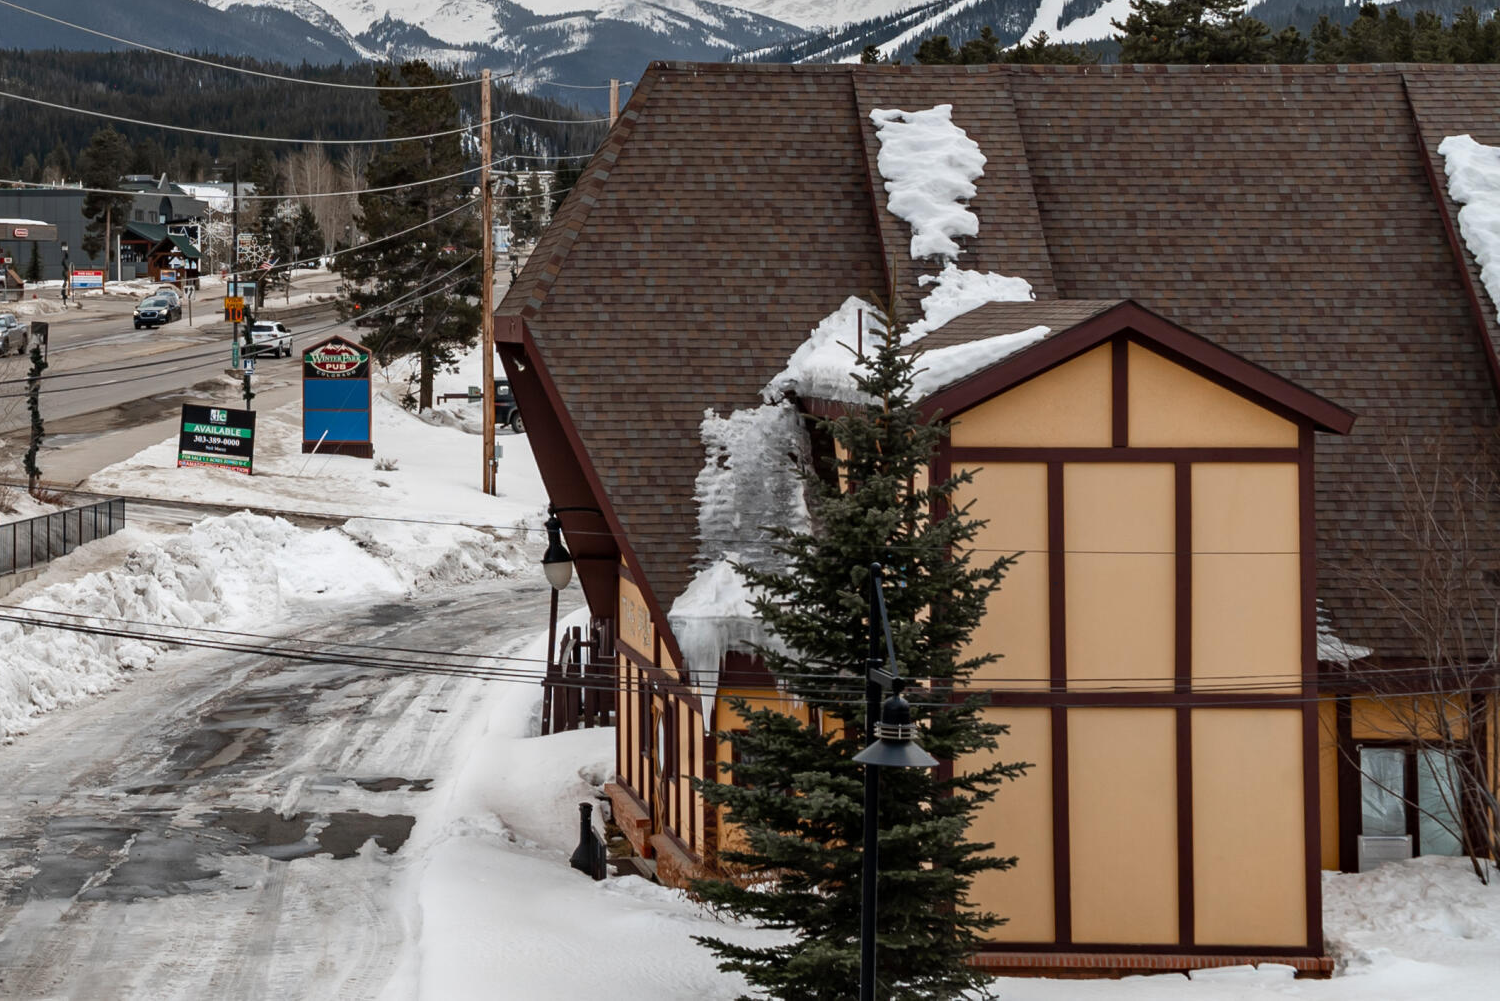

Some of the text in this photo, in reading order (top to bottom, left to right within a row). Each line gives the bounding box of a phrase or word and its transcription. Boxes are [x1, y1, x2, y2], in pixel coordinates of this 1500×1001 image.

[316, 369, 356, 377] COLORADO
[194, 425, 241, 436] AVAILABLE
[193, 435, 240, 446] 303-389-0000
